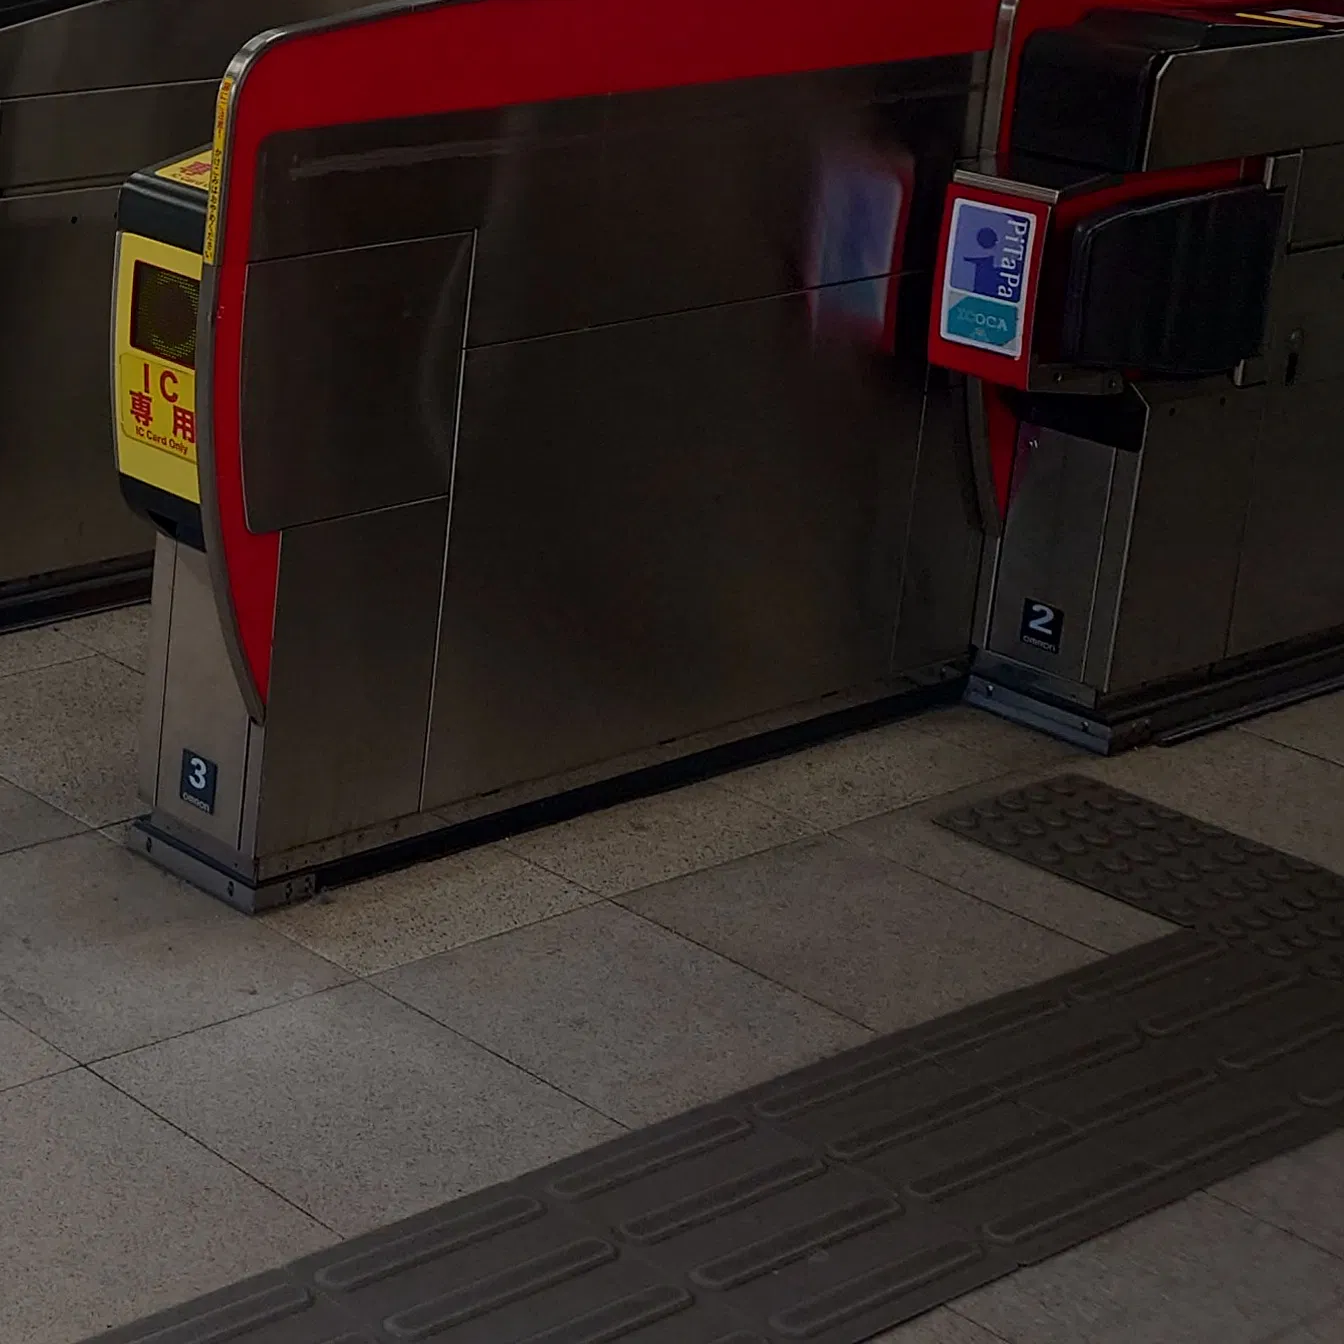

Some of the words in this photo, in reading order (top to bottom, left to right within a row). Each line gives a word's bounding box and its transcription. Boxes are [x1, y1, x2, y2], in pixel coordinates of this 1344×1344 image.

[997, 214, 1030, 302] PiTaPa
[143, 362, 179, 404] IC
[129, 389, 196, 444] 専用
[135, 425, 145, 438] IC
[146, 429, 167, 446] Card
[168, 437, 189, 456] Only
[1028, 604, 1055, 636] 2
[189, 758, 207, 789] 3
